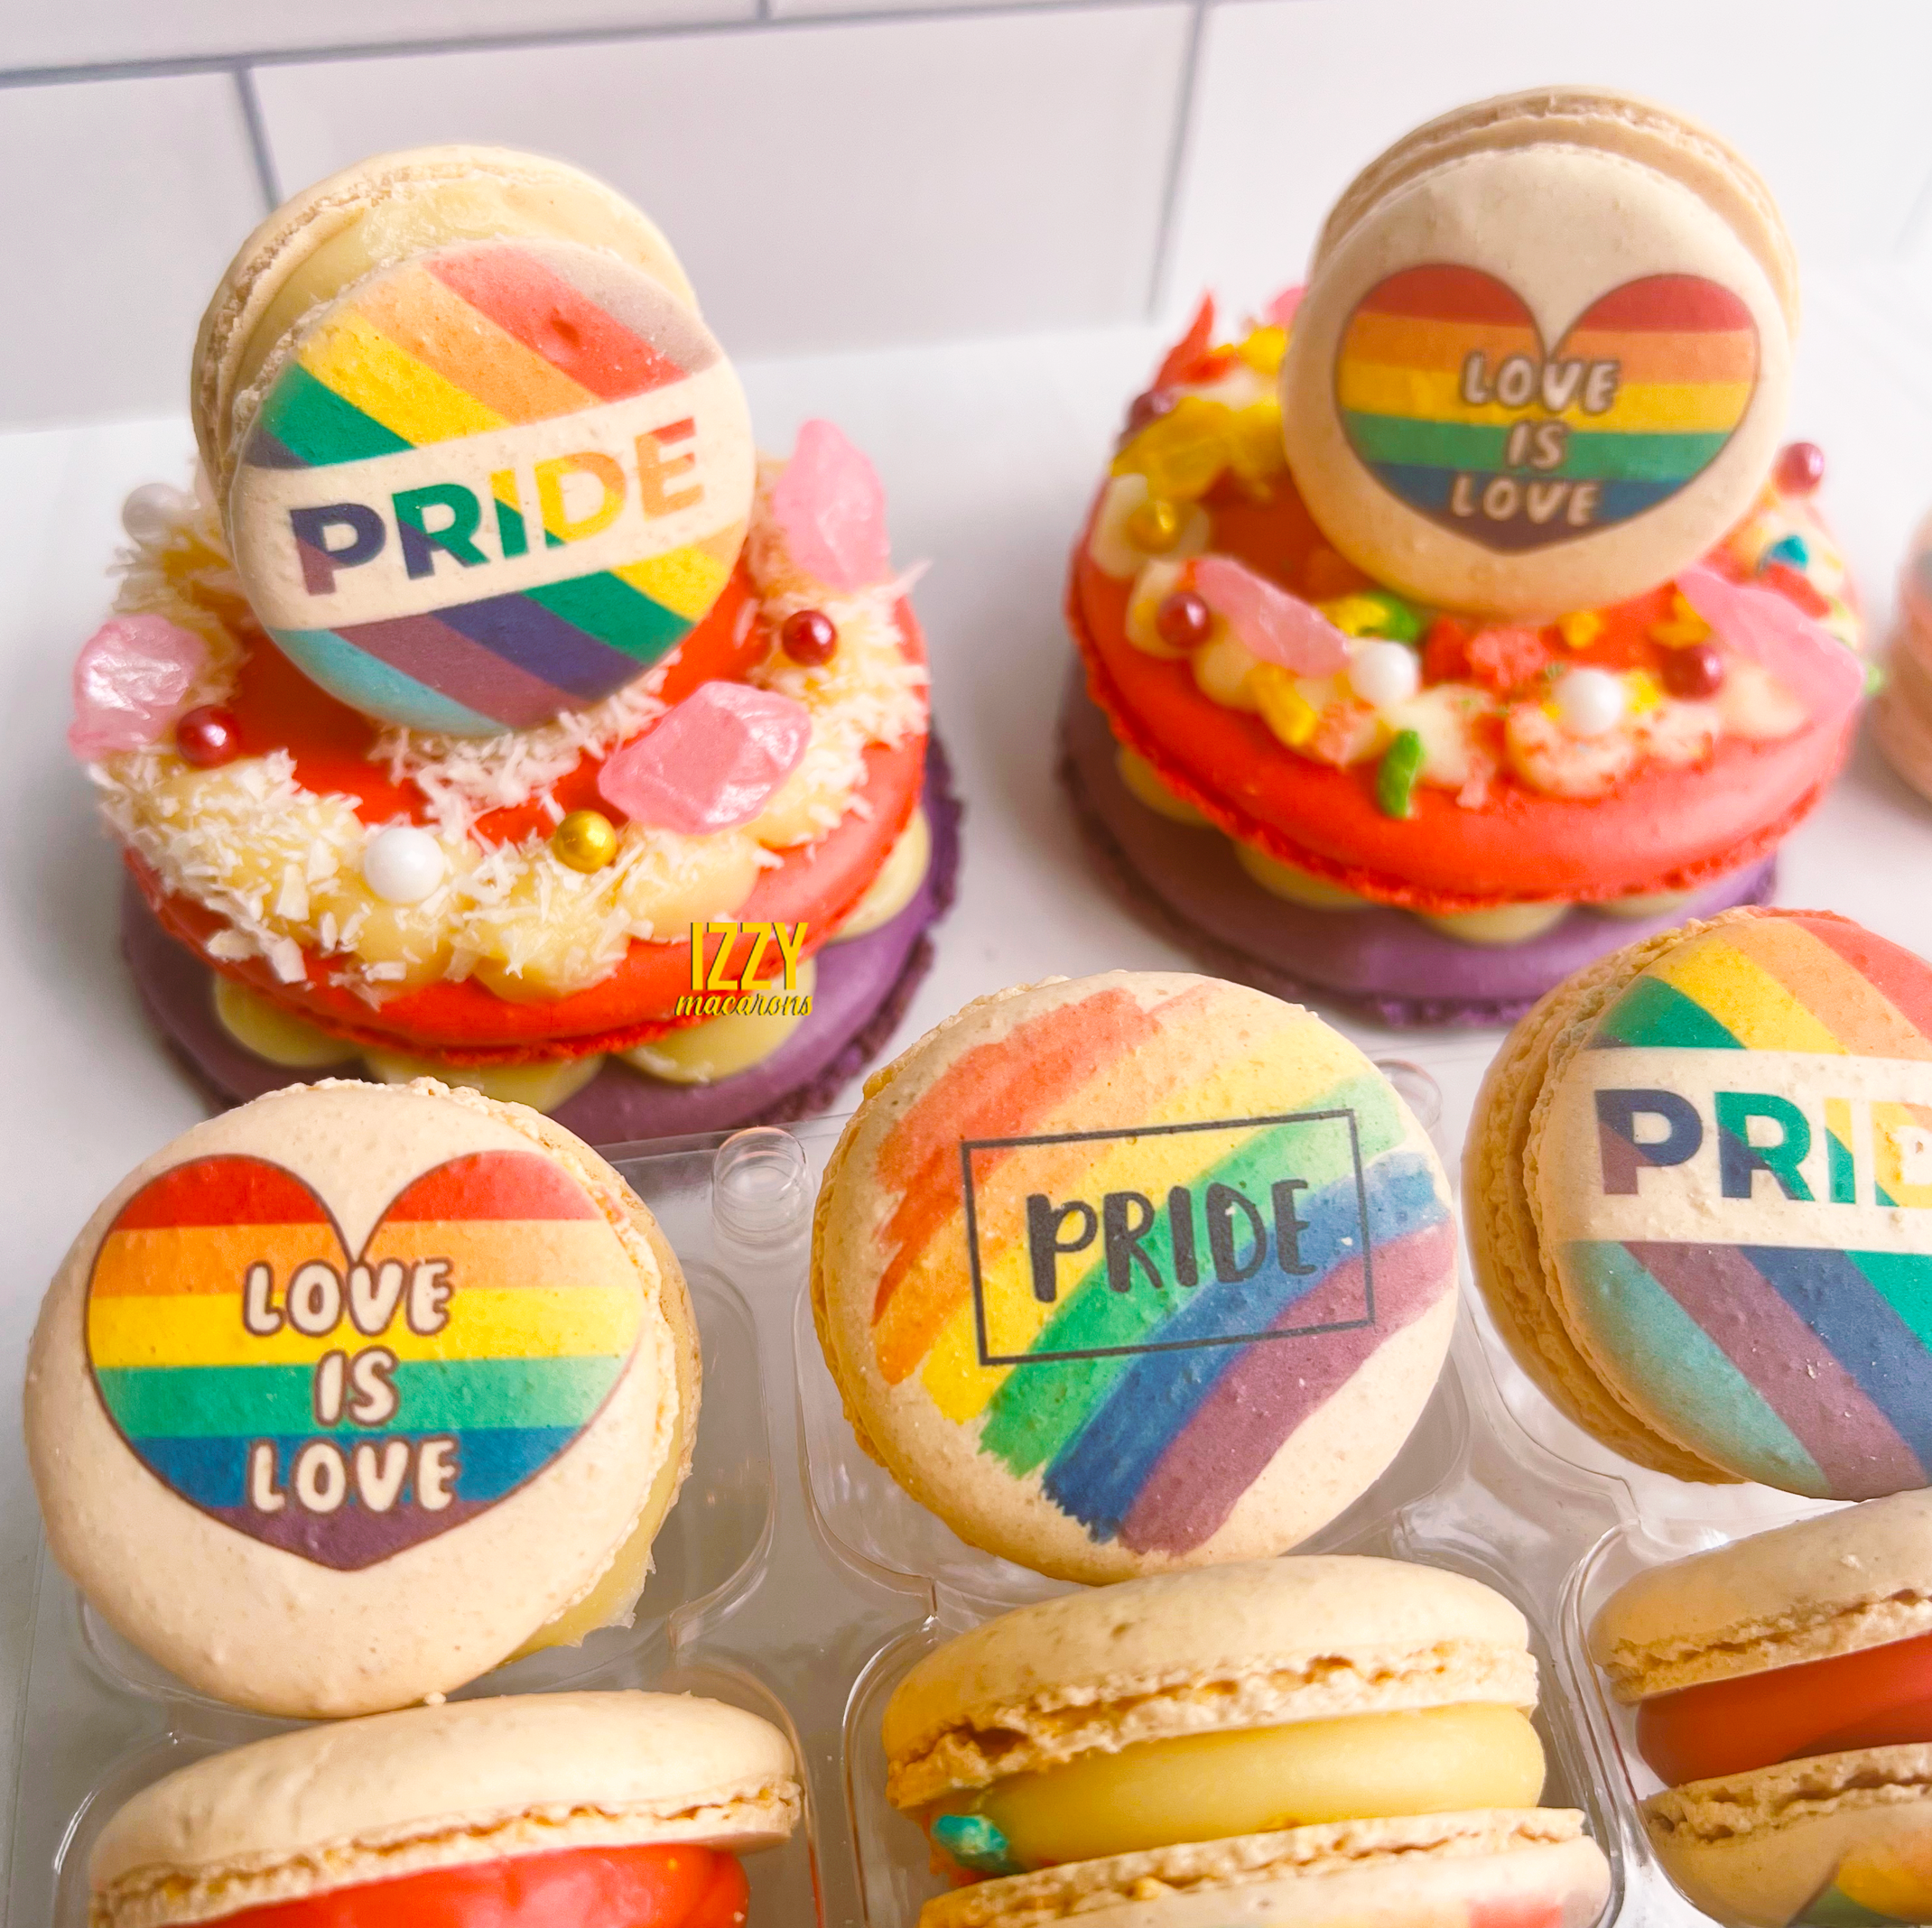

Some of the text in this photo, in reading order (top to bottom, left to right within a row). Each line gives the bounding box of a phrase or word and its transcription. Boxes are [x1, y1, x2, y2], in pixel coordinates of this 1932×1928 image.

[1460, 351, 1621, 416] LOVE
[1504, 420, 1568, 471] IS
[289, 417, 705, 596] PRIDE
[1450, 474, 1602, 527] LOVE
[1026, 1178, 1316, 1302] PRIDE
[243, 1256, 454, 1337] LOVE
[313, 1345, 400, 1427] IS
[247, 1433, 460, 1514] LOVE
